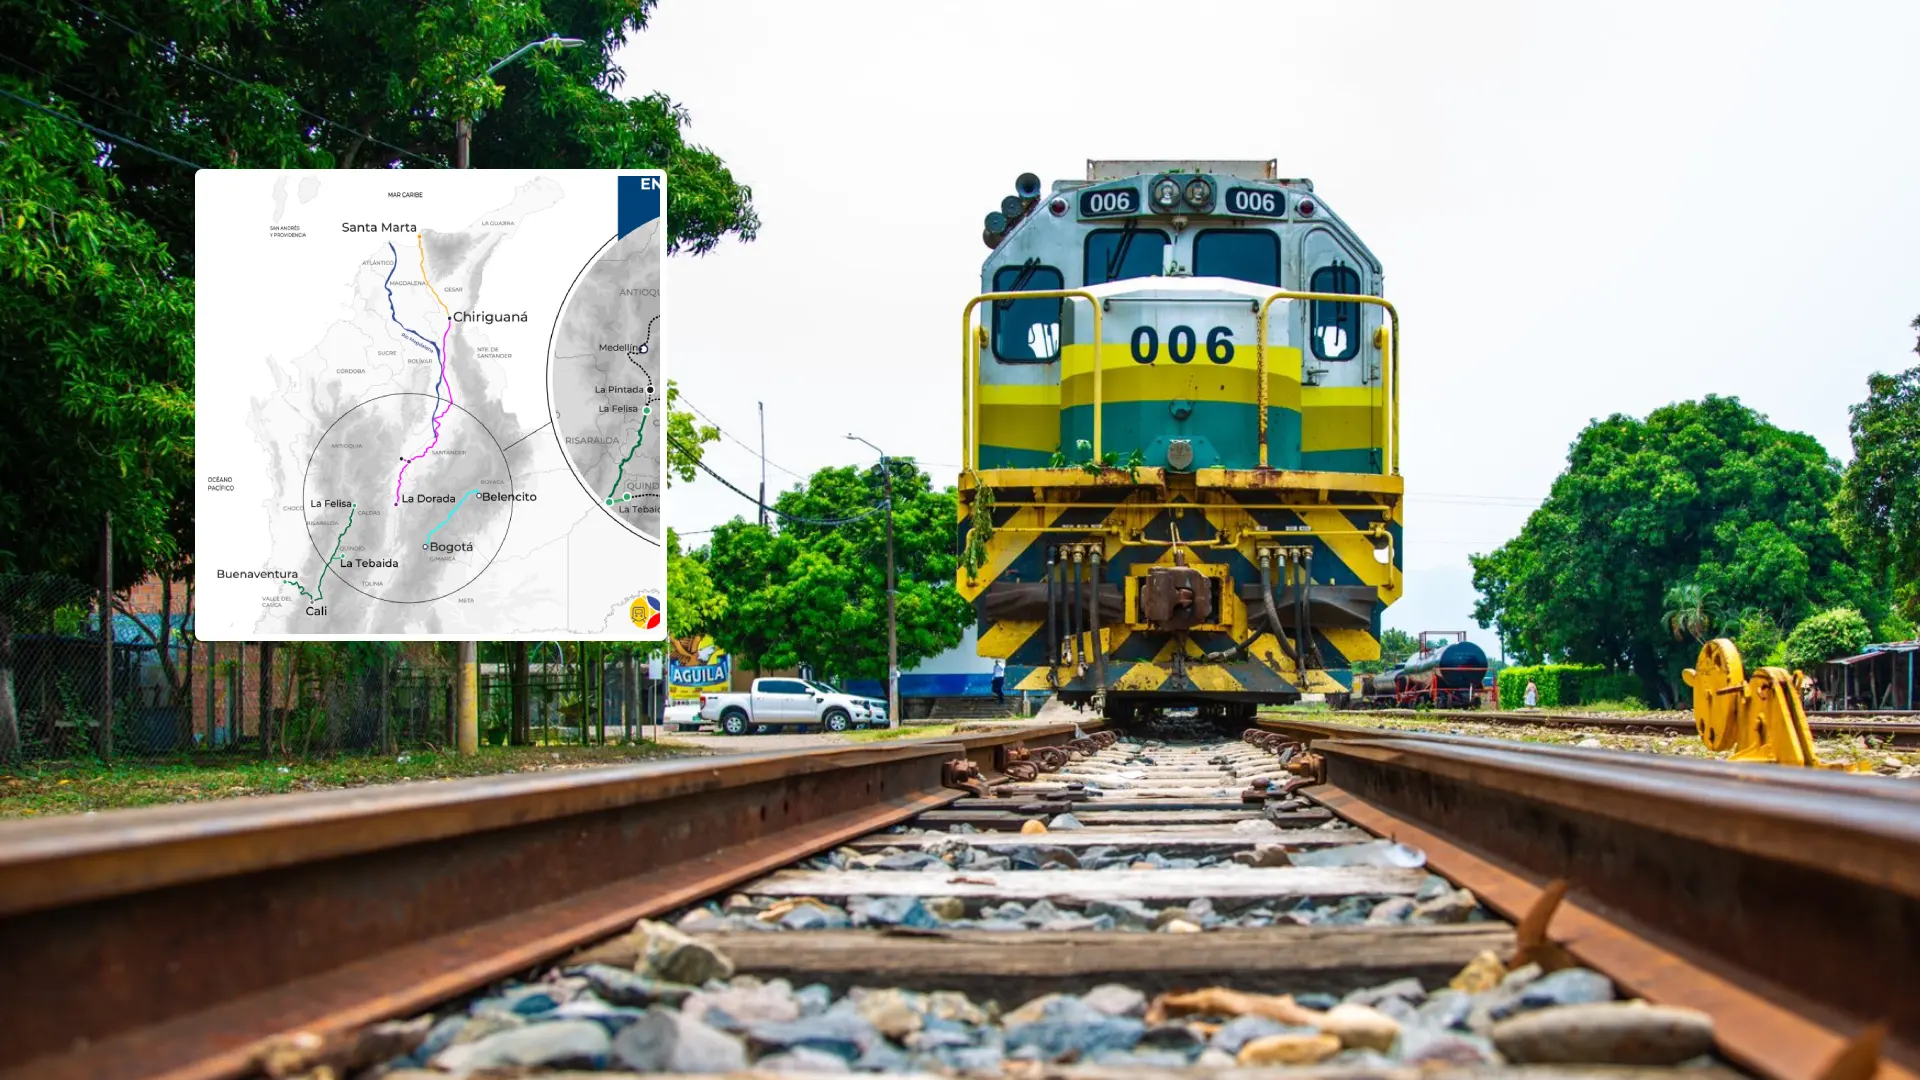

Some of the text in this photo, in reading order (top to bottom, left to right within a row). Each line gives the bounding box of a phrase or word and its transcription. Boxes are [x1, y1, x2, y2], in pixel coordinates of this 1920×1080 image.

[1090, 192, 1130, 212] 006
[1236, 190, 1276, 212] 006
[1130, 326, 1235, 364] 006
[673, 666, 724, 682] AGUILA
